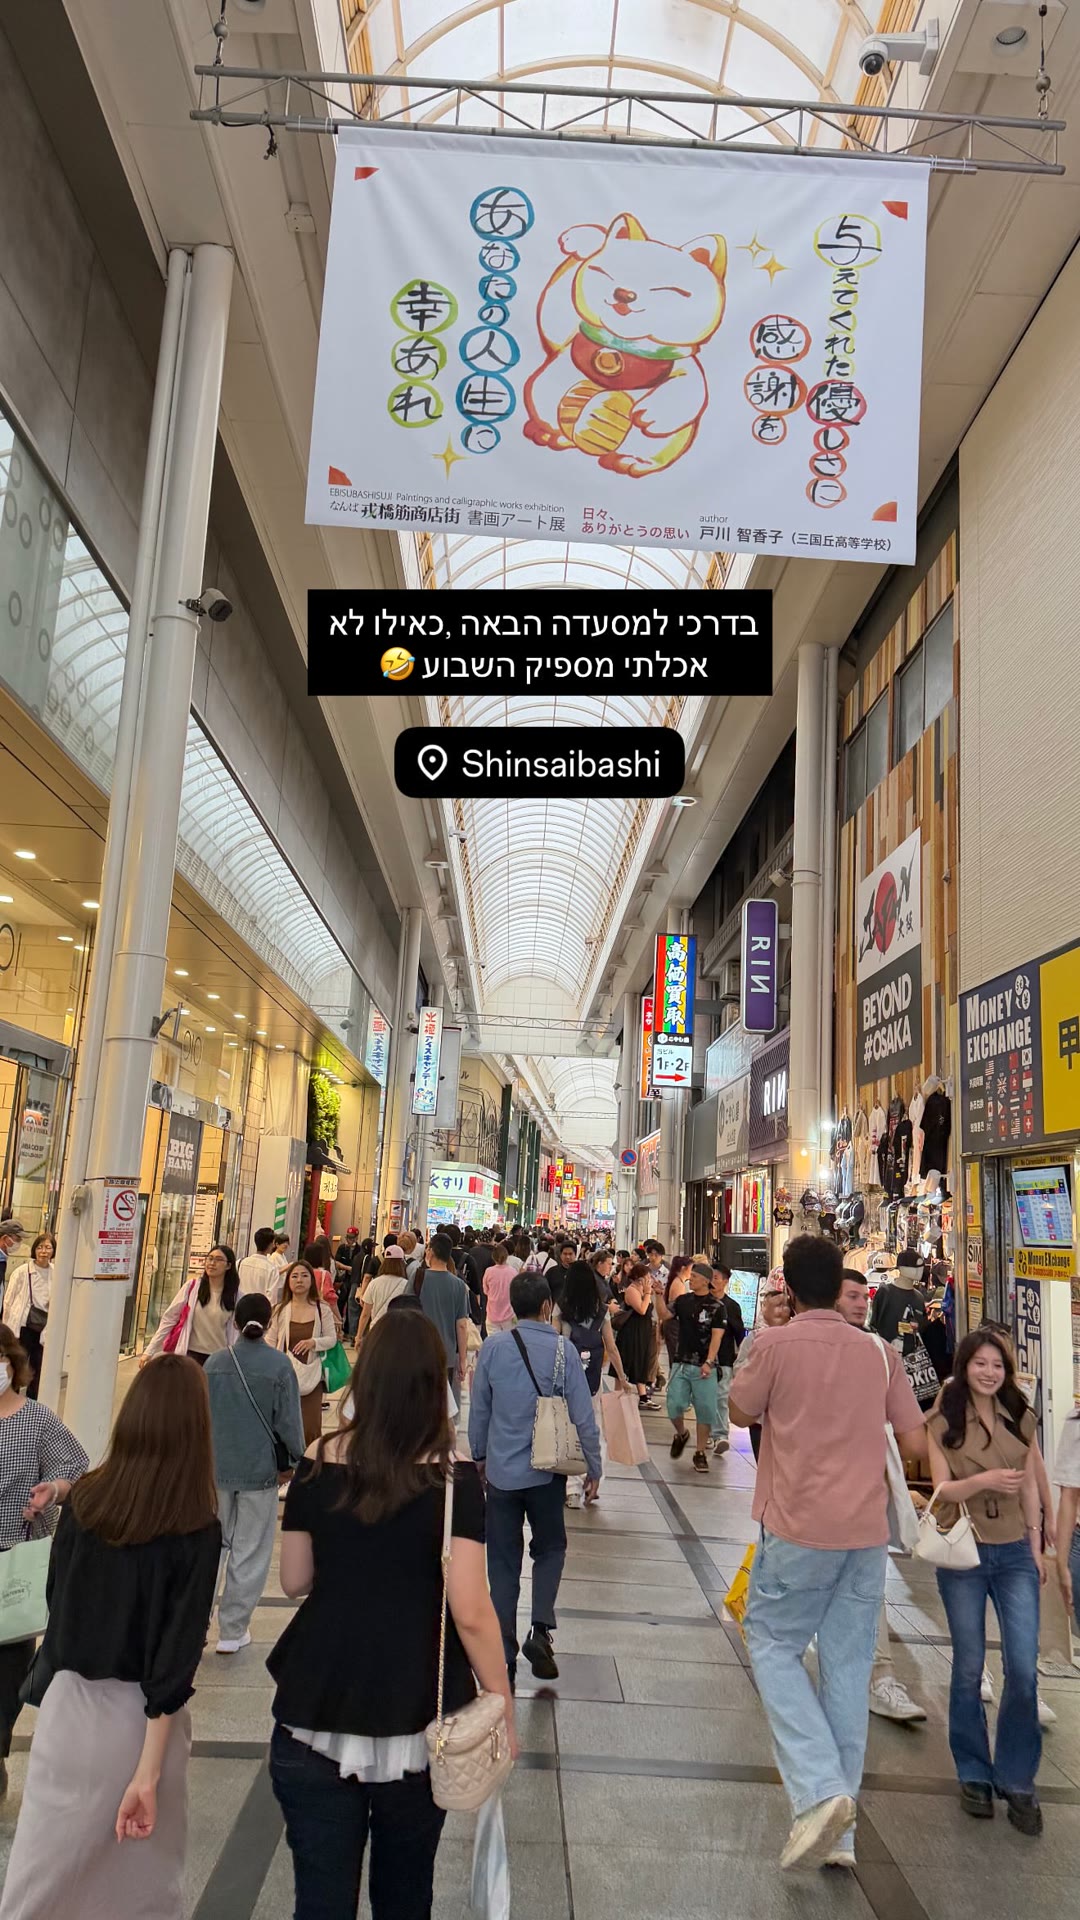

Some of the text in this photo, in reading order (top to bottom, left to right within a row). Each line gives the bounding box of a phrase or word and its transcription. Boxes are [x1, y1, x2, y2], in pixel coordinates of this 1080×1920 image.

[462, 188, 528, 450] あなたの人生に
[393, 282, 452, 424] 幸あれ
[746, 317, 799, 442] 感謝を
[329, 500, 566, 532] なんば 戎橋筋商店街 書画アート展
[396, 492, 432, 505] Paintings
[434, 495, 450, 505] and
[451, 496, 497, 509] calligraphic
[499, 501, 522, 510] works
[524, 502, 565, 513] exhibition
[582, 521, 690, 541] ありがとうの思い
[699, 514, 728, 523] author
[699, 525, 731, 542] 戸川
[736, 527, 784, 545] 智香子
[664, 941, 687, 1026] 高価買取
[863, 972, 912, 1032] BEYOND
[863, 1015, 912, 1066] #OSAKA
[967, 1016, 1032, 1064] EXCHANGE
[169, 1138, 195, 1160] BIG
[167, 1156, 193, 1171] BANG
[967, 1244, 982, 1263] SIM
[907, 1366, 938, 1388] OKYO
